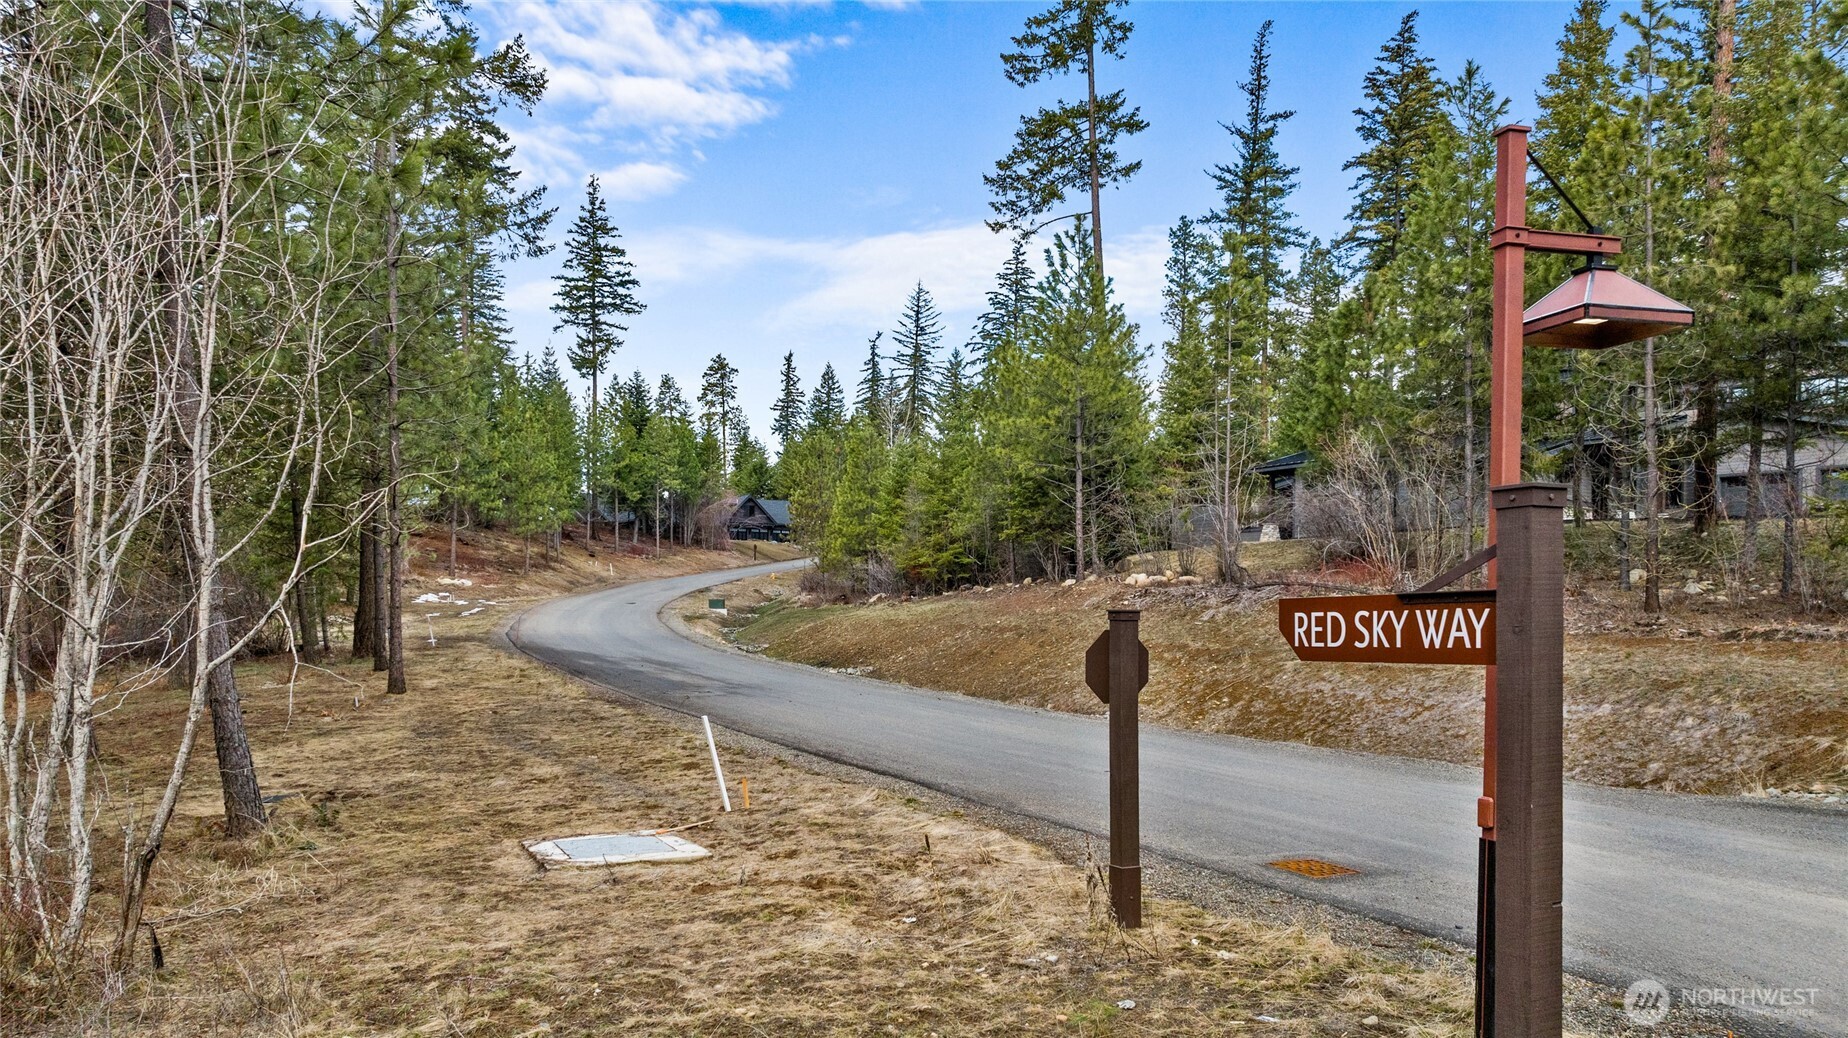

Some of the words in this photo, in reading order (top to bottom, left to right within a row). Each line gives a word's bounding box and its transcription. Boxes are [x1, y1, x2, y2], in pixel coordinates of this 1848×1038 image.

[1294, 611, 1346, 647] RED
[1354, 610, 1409, 648] SKY
[1415, 607, 1491, 649] WAY
